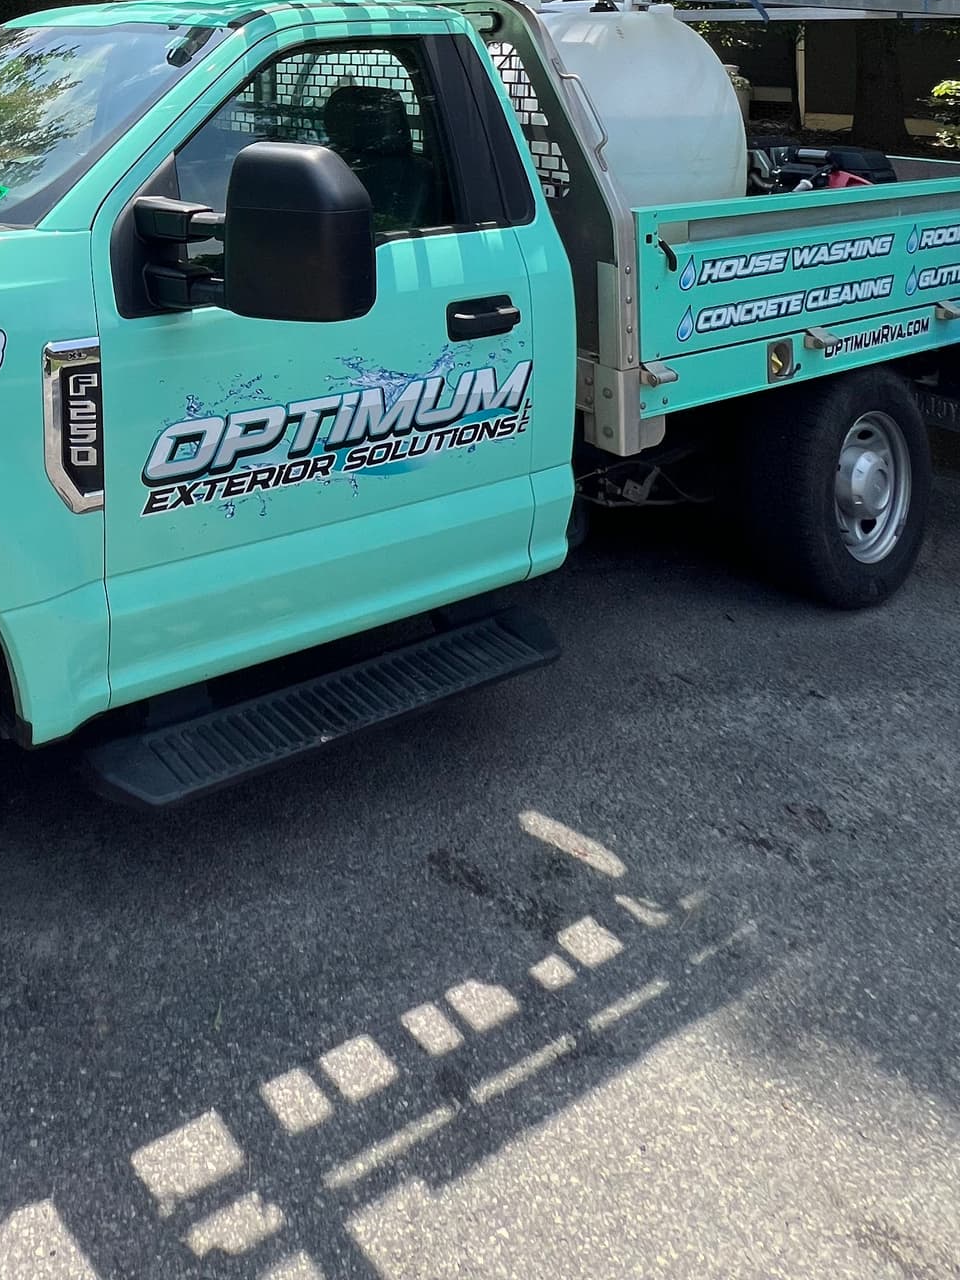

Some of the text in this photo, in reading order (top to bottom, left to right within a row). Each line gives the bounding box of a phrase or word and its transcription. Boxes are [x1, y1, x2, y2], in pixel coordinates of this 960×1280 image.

[697, 234, 895, 286] HOUSE WASHING
[919, 224, 960, 250] ROO
[695, 275, 894, 333] CONCRETE CLEANING
[918, 263, 960, 290] GUTT
[142, 361, 532, 486] OPTIMUM
[142, 416, 517, 517] EXTERIOR SOLUTIONS
